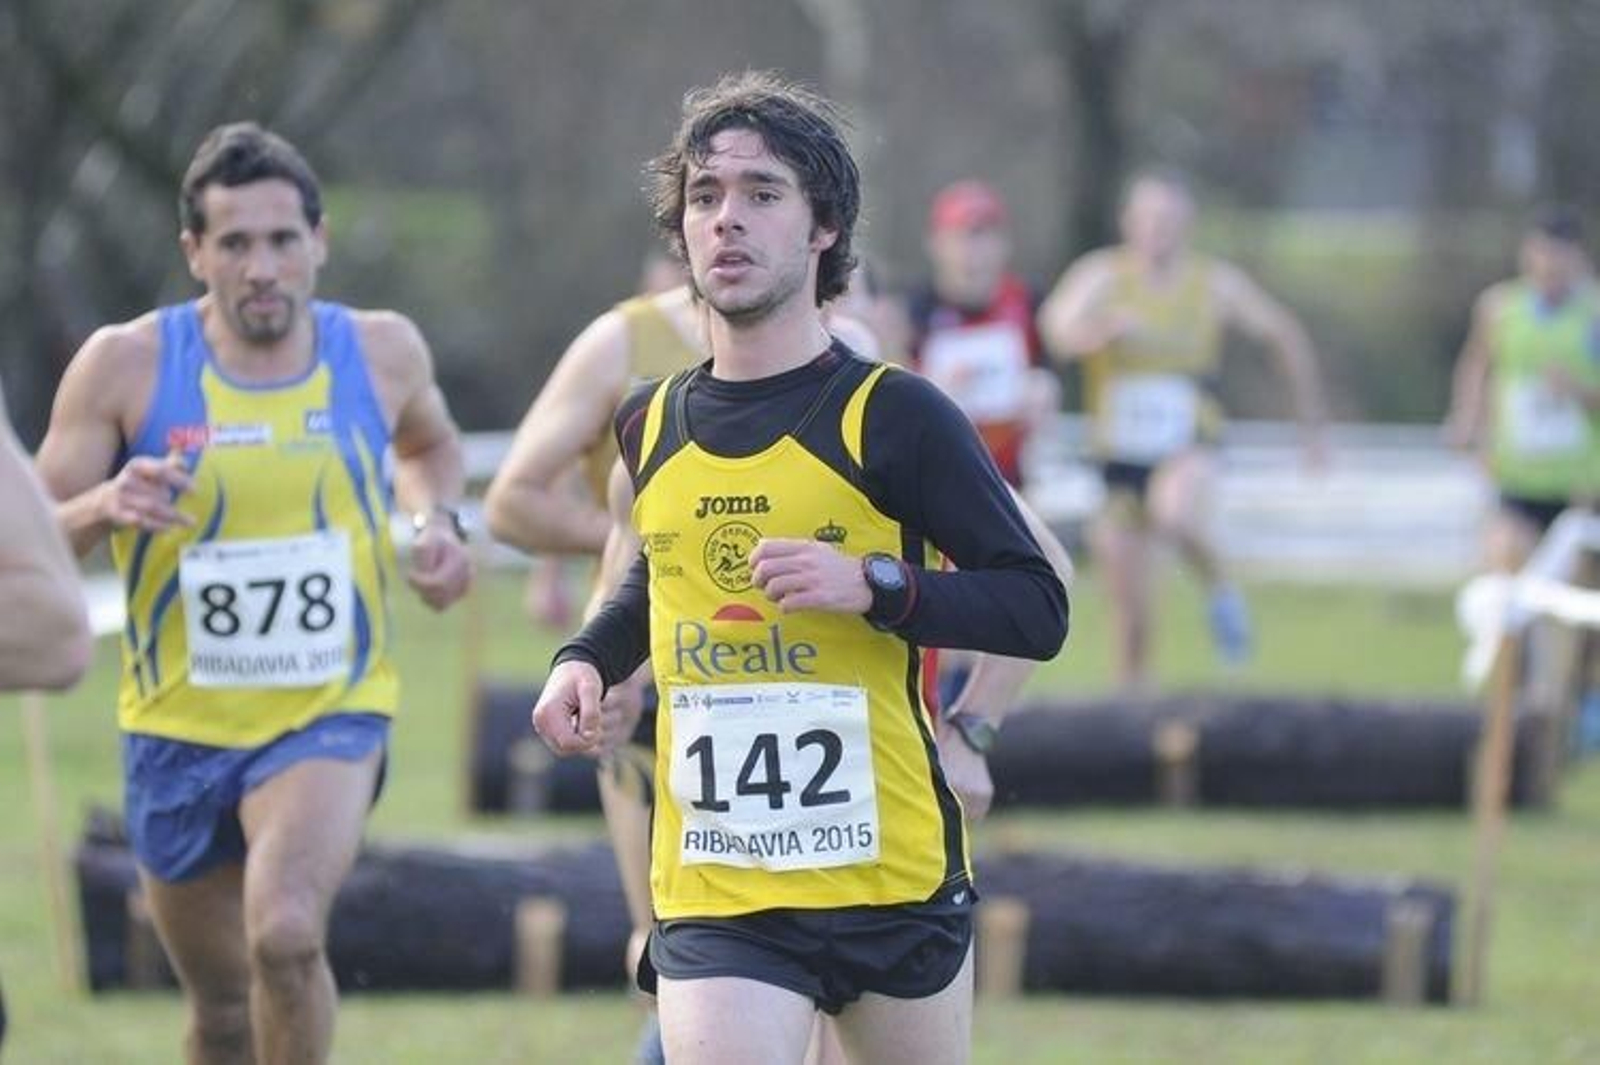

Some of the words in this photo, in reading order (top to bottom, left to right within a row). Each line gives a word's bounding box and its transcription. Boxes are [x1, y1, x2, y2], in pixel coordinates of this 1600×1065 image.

[201, 573, 335, 638] 878
[675, 620, 818, 679] Reale
[686, 729, 851, 812] 142
[812, 823, 873, 852] 2015
